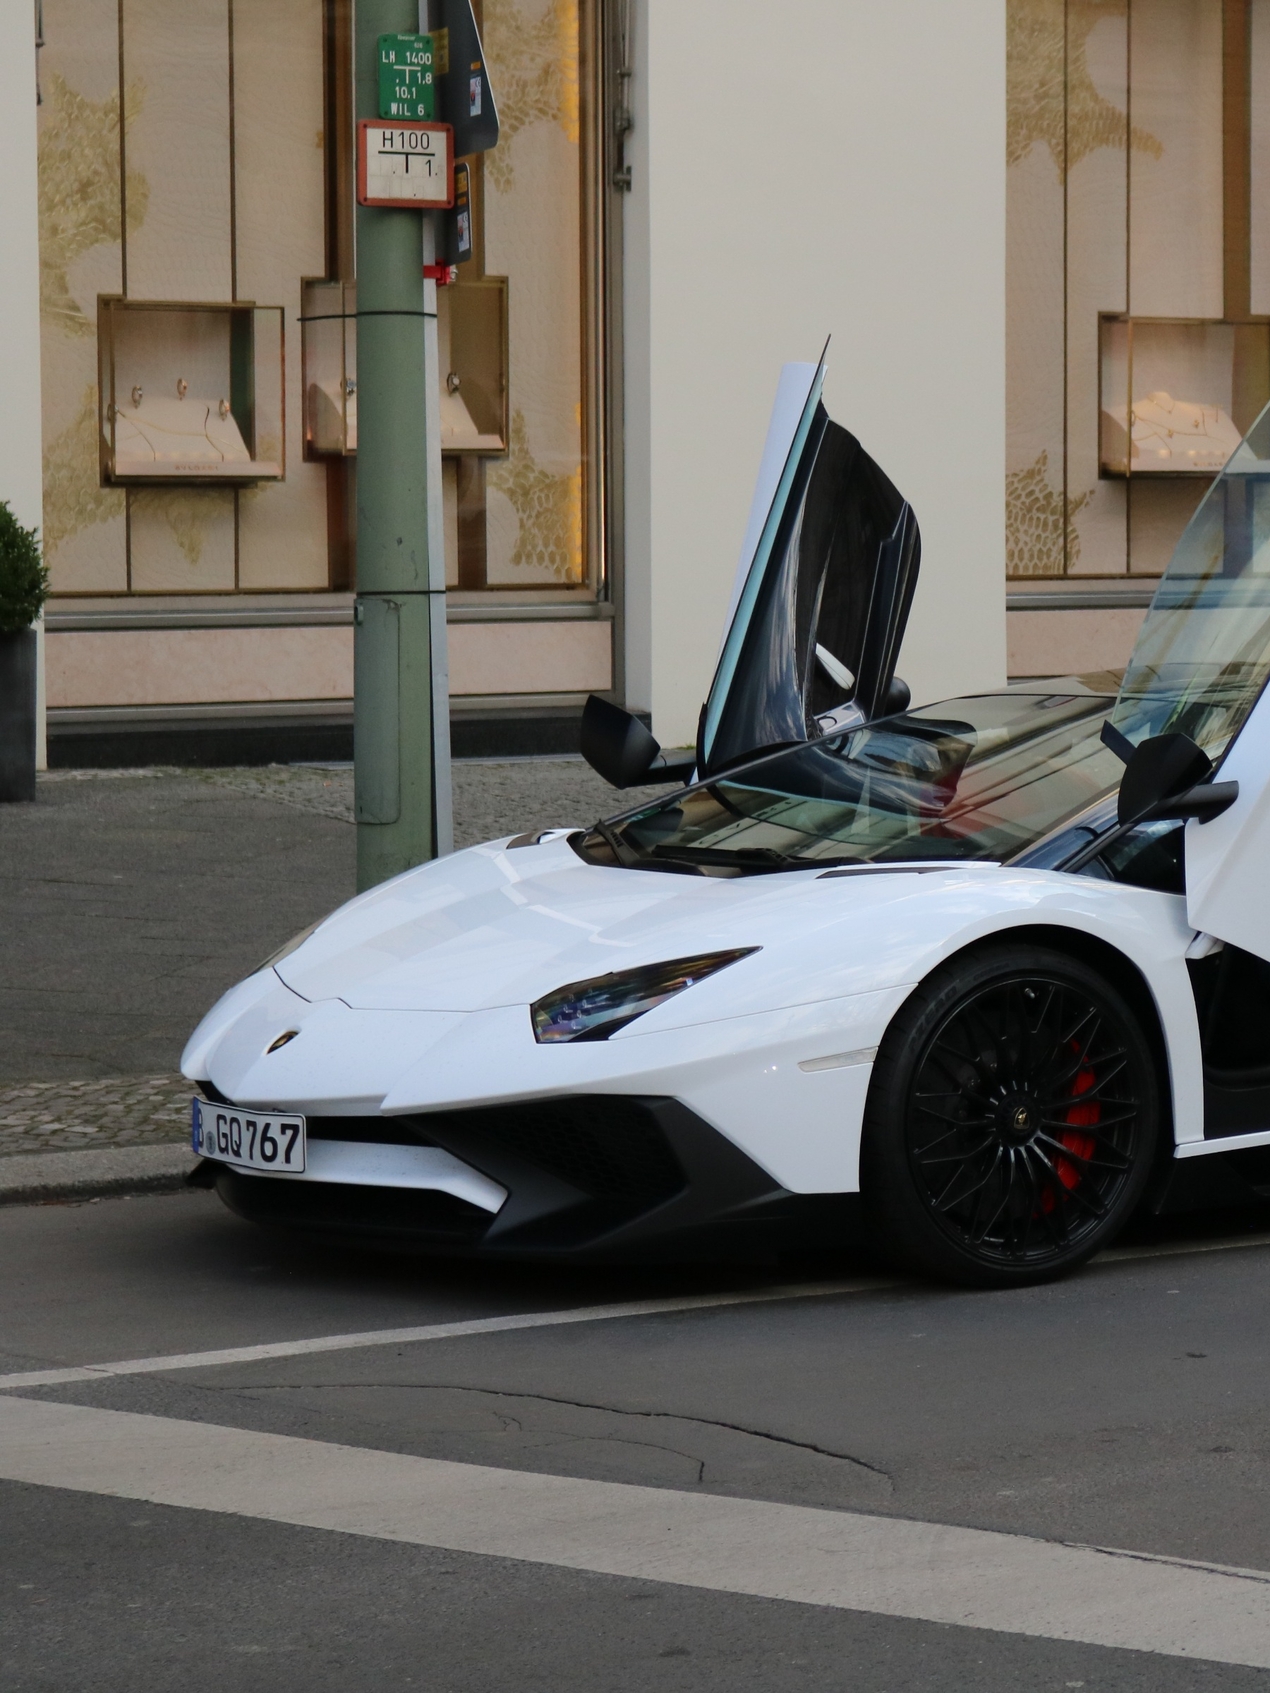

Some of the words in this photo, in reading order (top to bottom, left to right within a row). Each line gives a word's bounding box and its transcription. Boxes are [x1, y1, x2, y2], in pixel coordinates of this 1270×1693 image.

[382, 50, 396, 63] LH
[406, 51, 432, 65] 1400
[391, 102, 411, 116] WIL
[417, 104, 425, 117] 6
[382, 130, 430, 151] H100
[216, 1114, 242, 1158] GQ
[246, 1120, 300, 1164] 767
